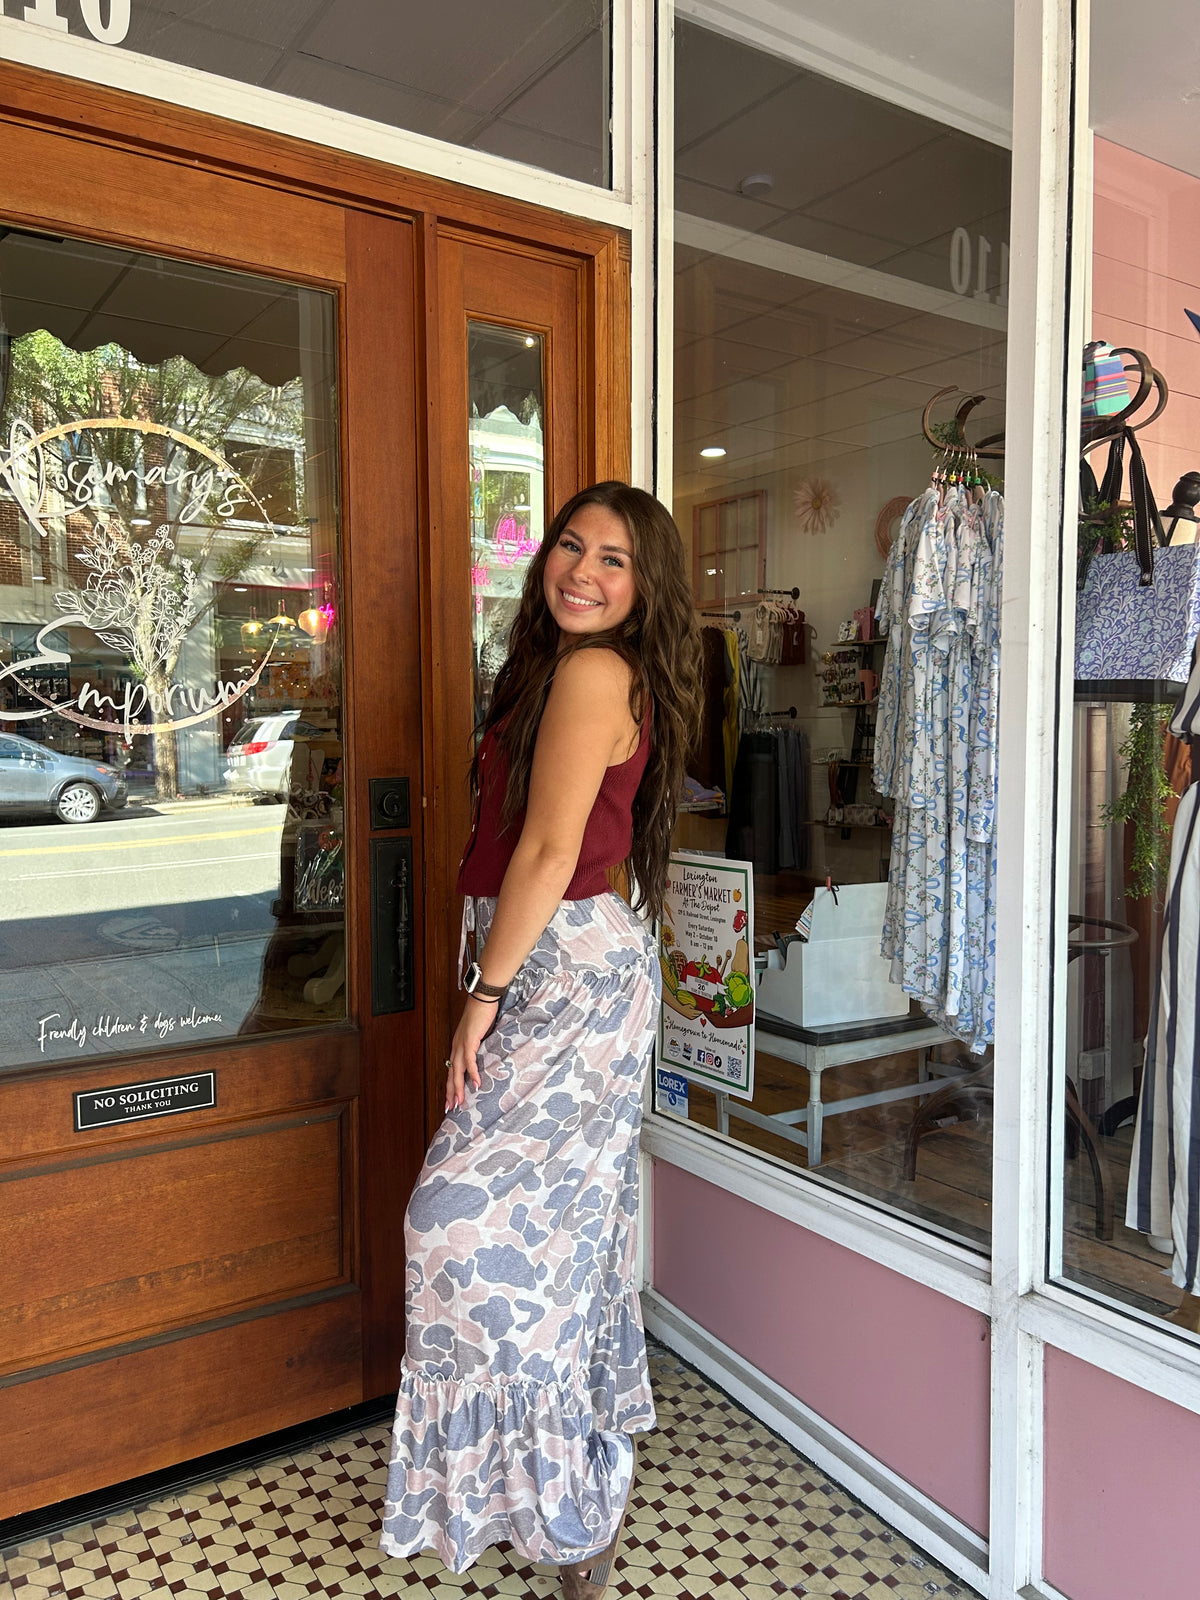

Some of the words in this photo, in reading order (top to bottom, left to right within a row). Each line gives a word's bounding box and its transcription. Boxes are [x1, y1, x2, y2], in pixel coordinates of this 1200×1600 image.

[0, 419, 249, 537] Rosemary's
[0, 615, 259, 745] Emporium
[683, 867, 718, 888] Lexington
[672, 881, 702, 899] FARMER'S
[703, 886, 731, 904] MARKET
[682, 897, 689, 908] At
[690, 898, 700, 909] The
[701, 900, 720, 914] Depot
[685, 930, 693, 938] May
[699, 932, 713, 941] October
[688, 922, 698, 931] Every
[698, 924, 714, 934] Saturday
[697, 983, 706, 992] 20
[92, 1015, 135, 1038] children
[140, 1014, 149, 1034] &
[154, 1012, 176, 1039] dogs
[669, 1020, 701, 1037] Homegrown
[701, 1031, 708, 1039] to
[708, 1032, 742, 1051] Homemade
[658, 1074, 686, 1094] LOREX
[93, 1096, 116, 1110] NO
[119, 1082, 199, 1106] SOLICITING
[124, 1103, 153, 1113] THANK
[154, 1099, 172, 1108] YOU
